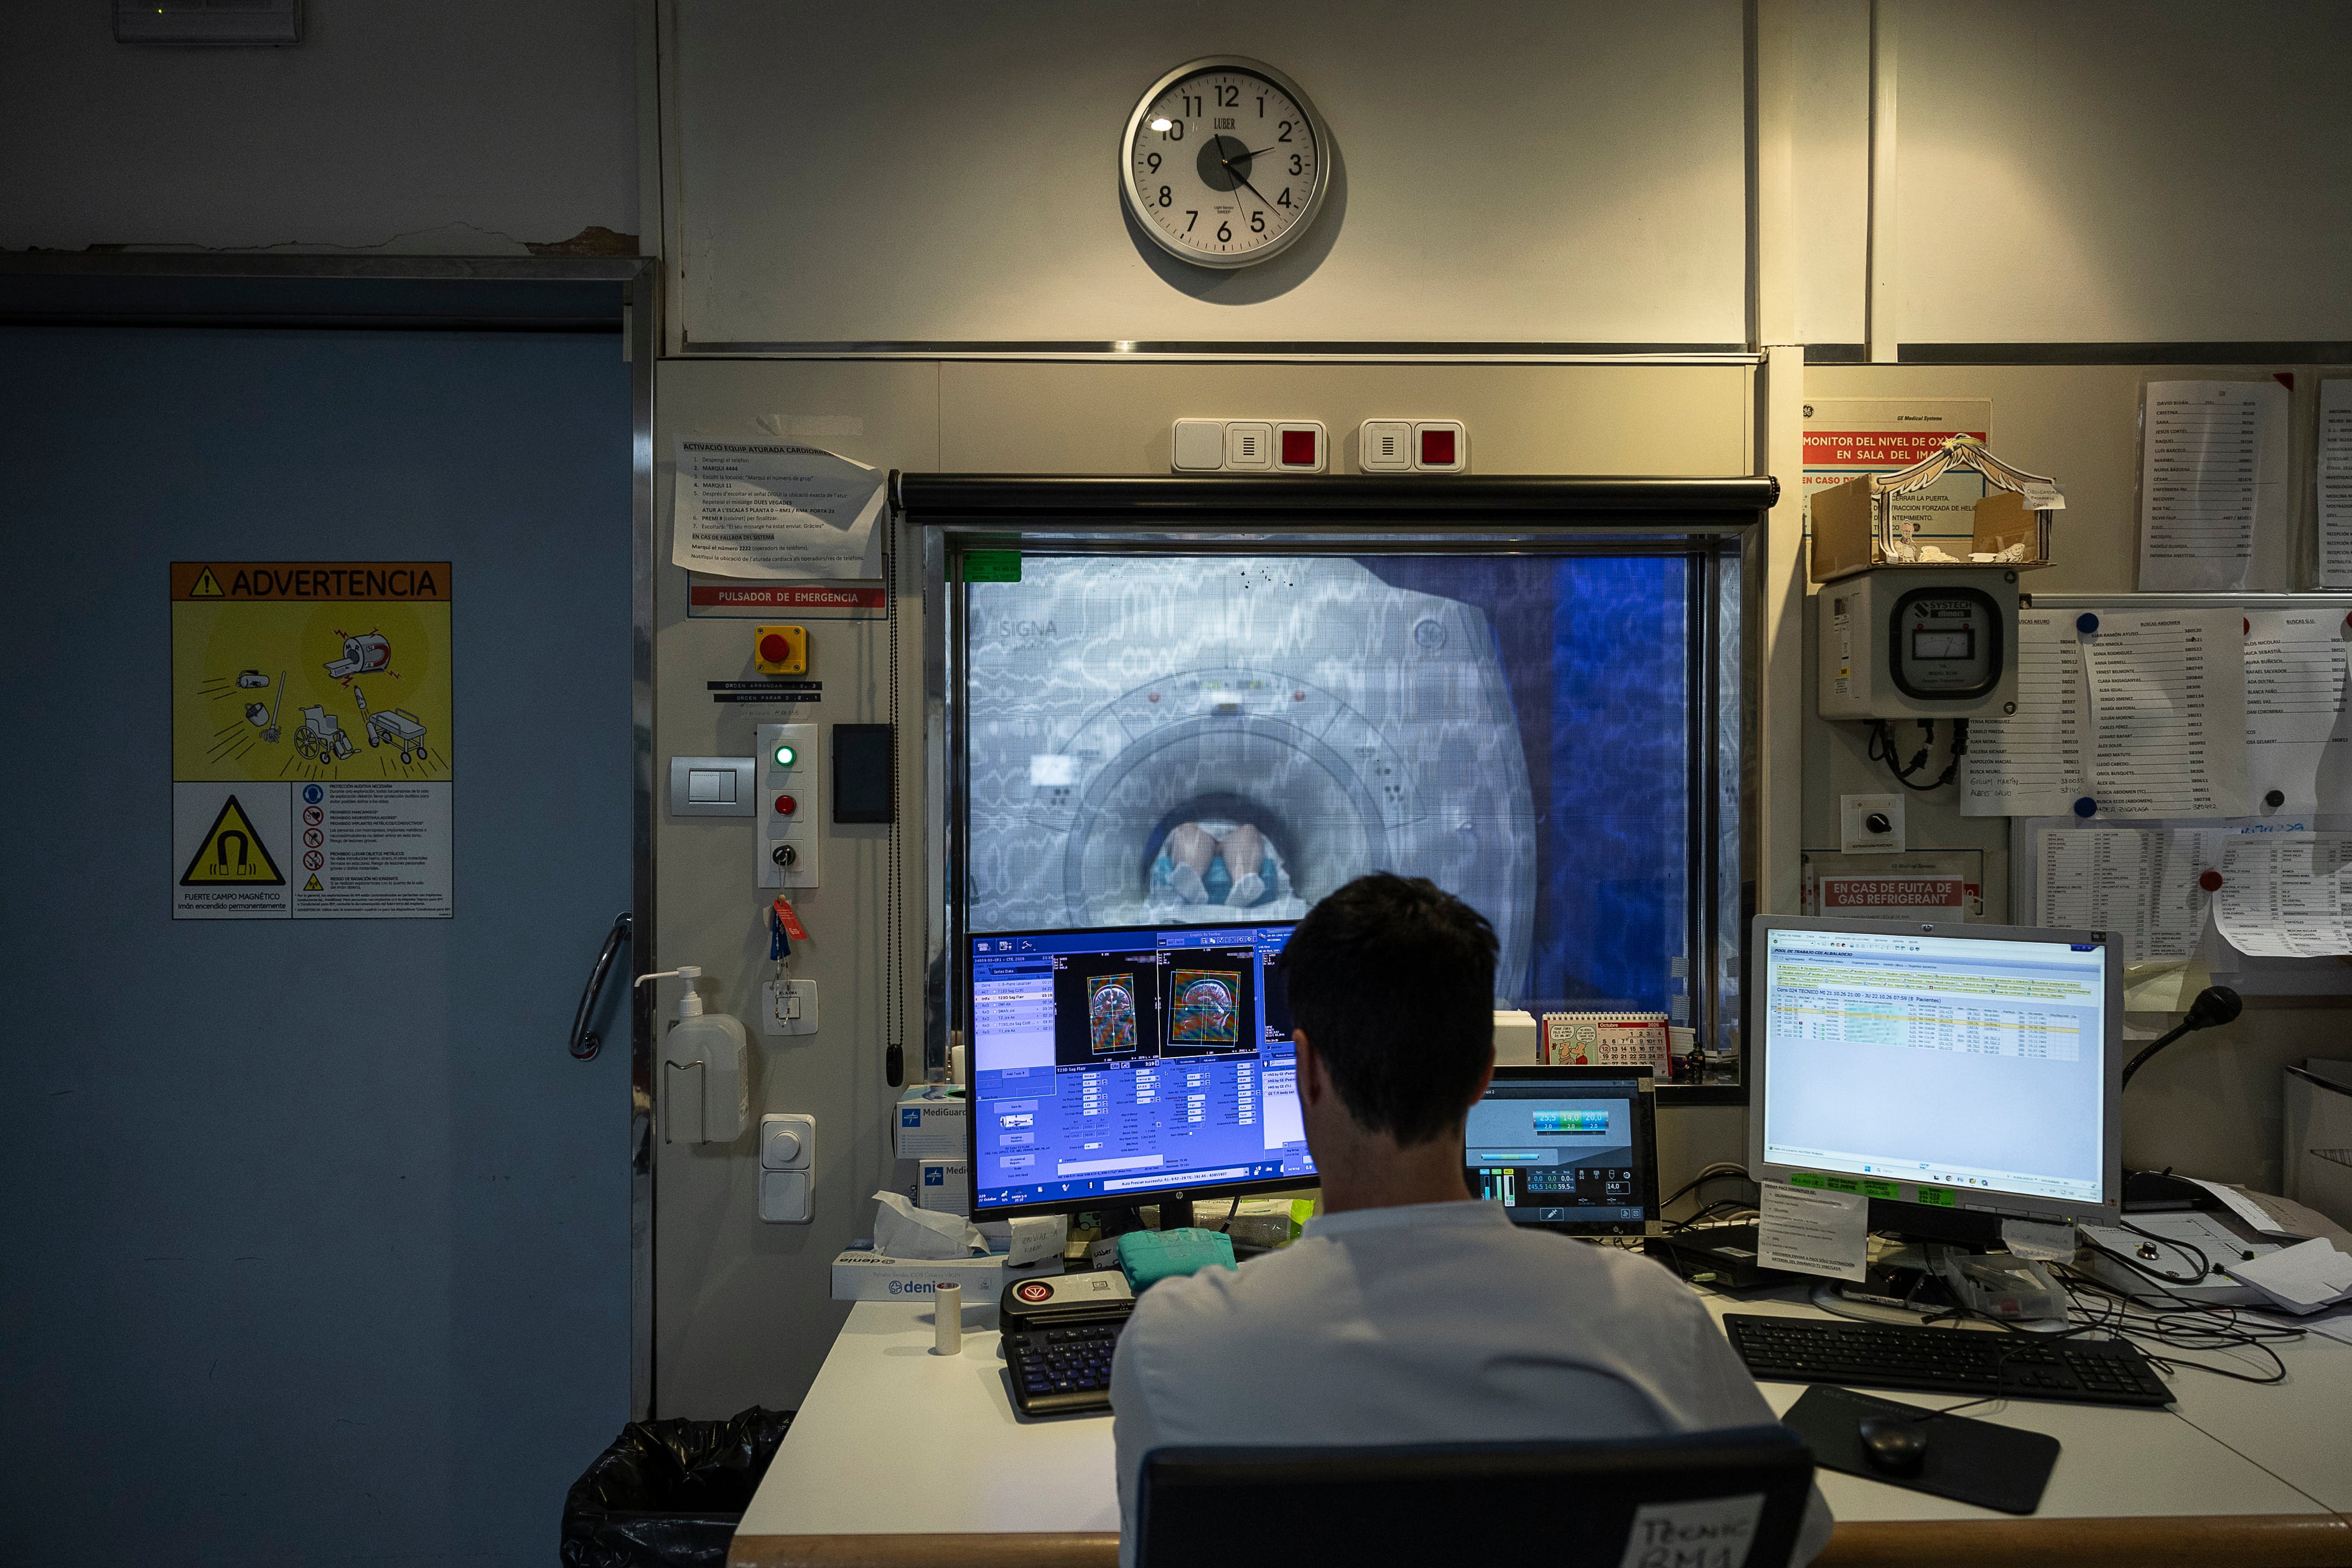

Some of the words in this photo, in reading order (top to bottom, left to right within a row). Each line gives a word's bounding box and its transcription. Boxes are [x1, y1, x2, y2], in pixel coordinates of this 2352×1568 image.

[1214, 85, 1239, 107] 12
[1183, 96, 1202, 117] 11
[1256, 96, 1264, 118] 1
[1214, 118, 1235, 129] LUBER
[1278, 121, 1292, 142] 2
[1147, 153, 1161, 174] 9
[1289, 154, 1302, 175] 3
[1159, 186, 1172, 207] 8
[1277, 188, 1291, 208] 4
[1186, 211, 1198, 231] 7
[1251, 212, 1265, 233] 5
[1217, 221, 1231, 242] 6
[684, 444, 722, 452] ACTIVACIÓ
[1803, 437, 1853, 446] MONITOR
[1856, 437, 1875, 446] DEL
[1879, 437, 1909, 446] NIVEL
[1913, 437, 1925, 446] DE
[1837, 450, 1851, 459] EN
[1857, 450, 1884, 459] SALA
[1890, 450, 1910, 459] DEL
[231, 570, 437, 596] ADVERTENCIA
[719, 592, 771, 602] PULSADOR
[777, 593, 789, 602] DE
[795, 593, 857, 603] EMERGENCIA
[1001, 620, 1056, 637] SIGNA
[184, 892, 210, 900] FUERTE
[212, 892, 238, 900] CAMPO
[240, 891, 280, 900] MAGNÉTICO
[1834, 883, 1847, 893] EN
[1851, 883, 1877, 893] CAS
[1880, 883, 1895, 893] DE
[1898, 883, 1933, 893] FUITA
[1937, 883, 1951, 893] DE
[228, 903, 286, 911] permanentemente
[1838, 894, 1864, 904] GAS
[1867, 894, 1948, 904] REFRIGERANT
[903, 1280, 936, 1292] deni
